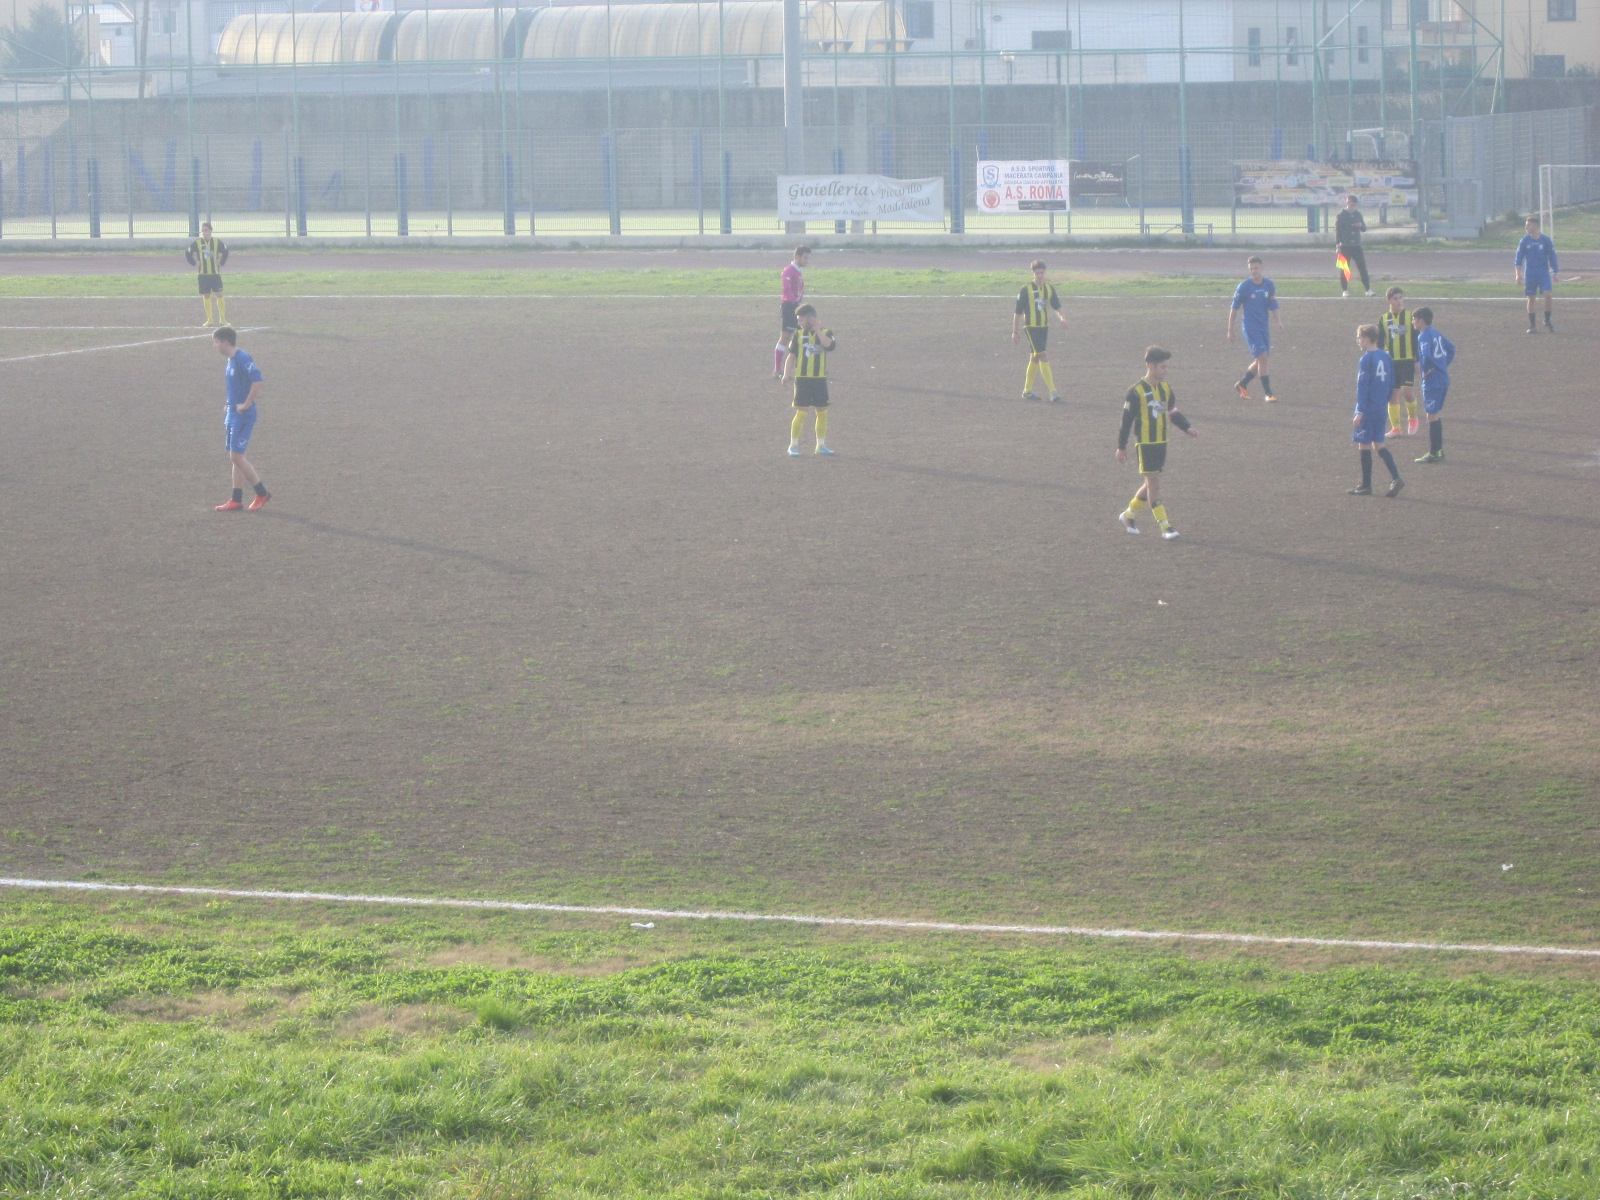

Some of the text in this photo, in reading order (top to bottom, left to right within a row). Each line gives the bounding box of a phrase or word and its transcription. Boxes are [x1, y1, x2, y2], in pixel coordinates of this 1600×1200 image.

[788, 181, 869, 200] Gioielleria
[1005, 185, 1064, 200] A.S. ROMA
[877, 197, 931, 215] Maddalena
[1375, 359, 1387, 382] 4
